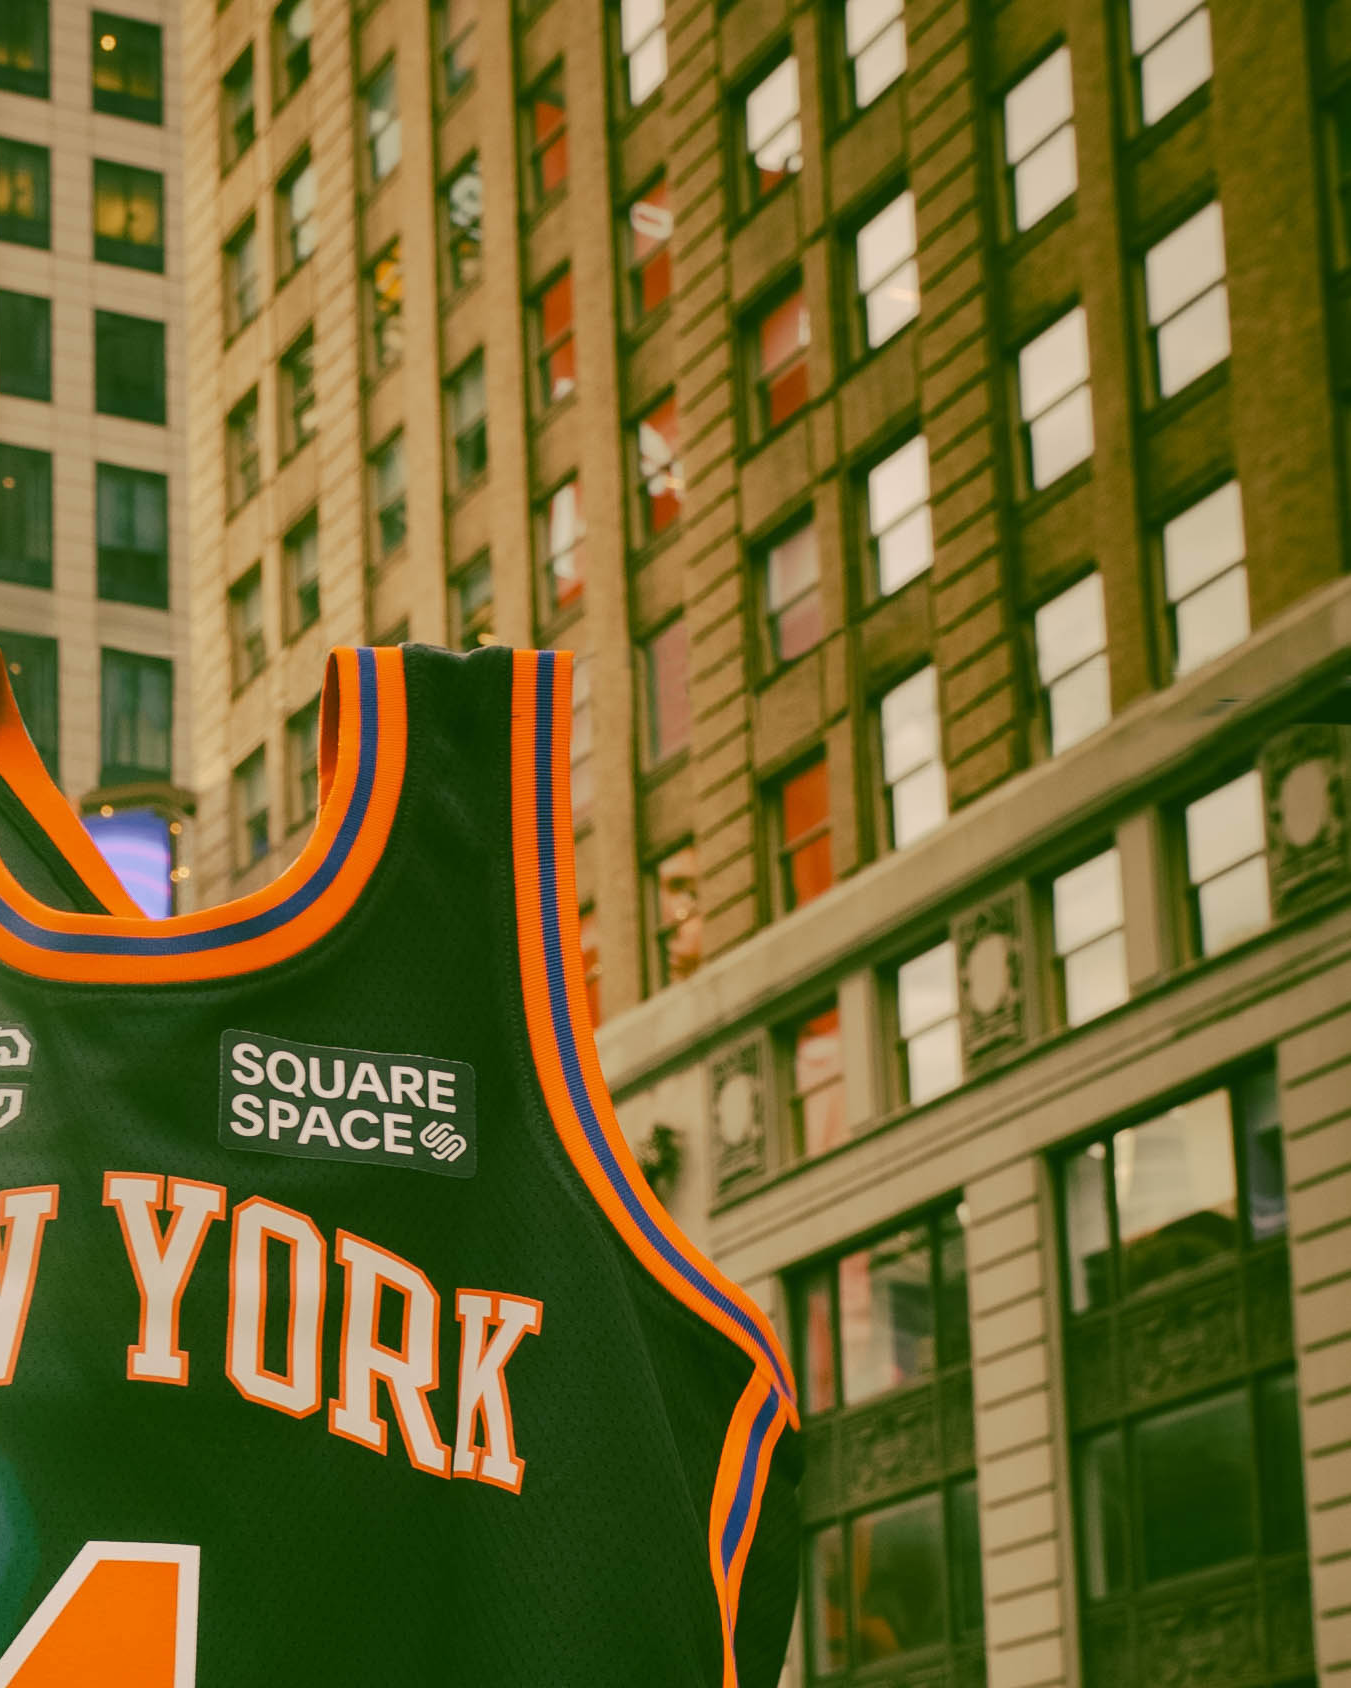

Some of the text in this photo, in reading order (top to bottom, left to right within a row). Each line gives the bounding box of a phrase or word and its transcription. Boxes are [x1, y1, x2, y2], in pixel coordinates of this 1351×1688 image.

[231, 1043, 457, 1113] SQUARE
[229, 1093, 414, 1155] SPACE
[102, 1171, 543, 1495] YORK
